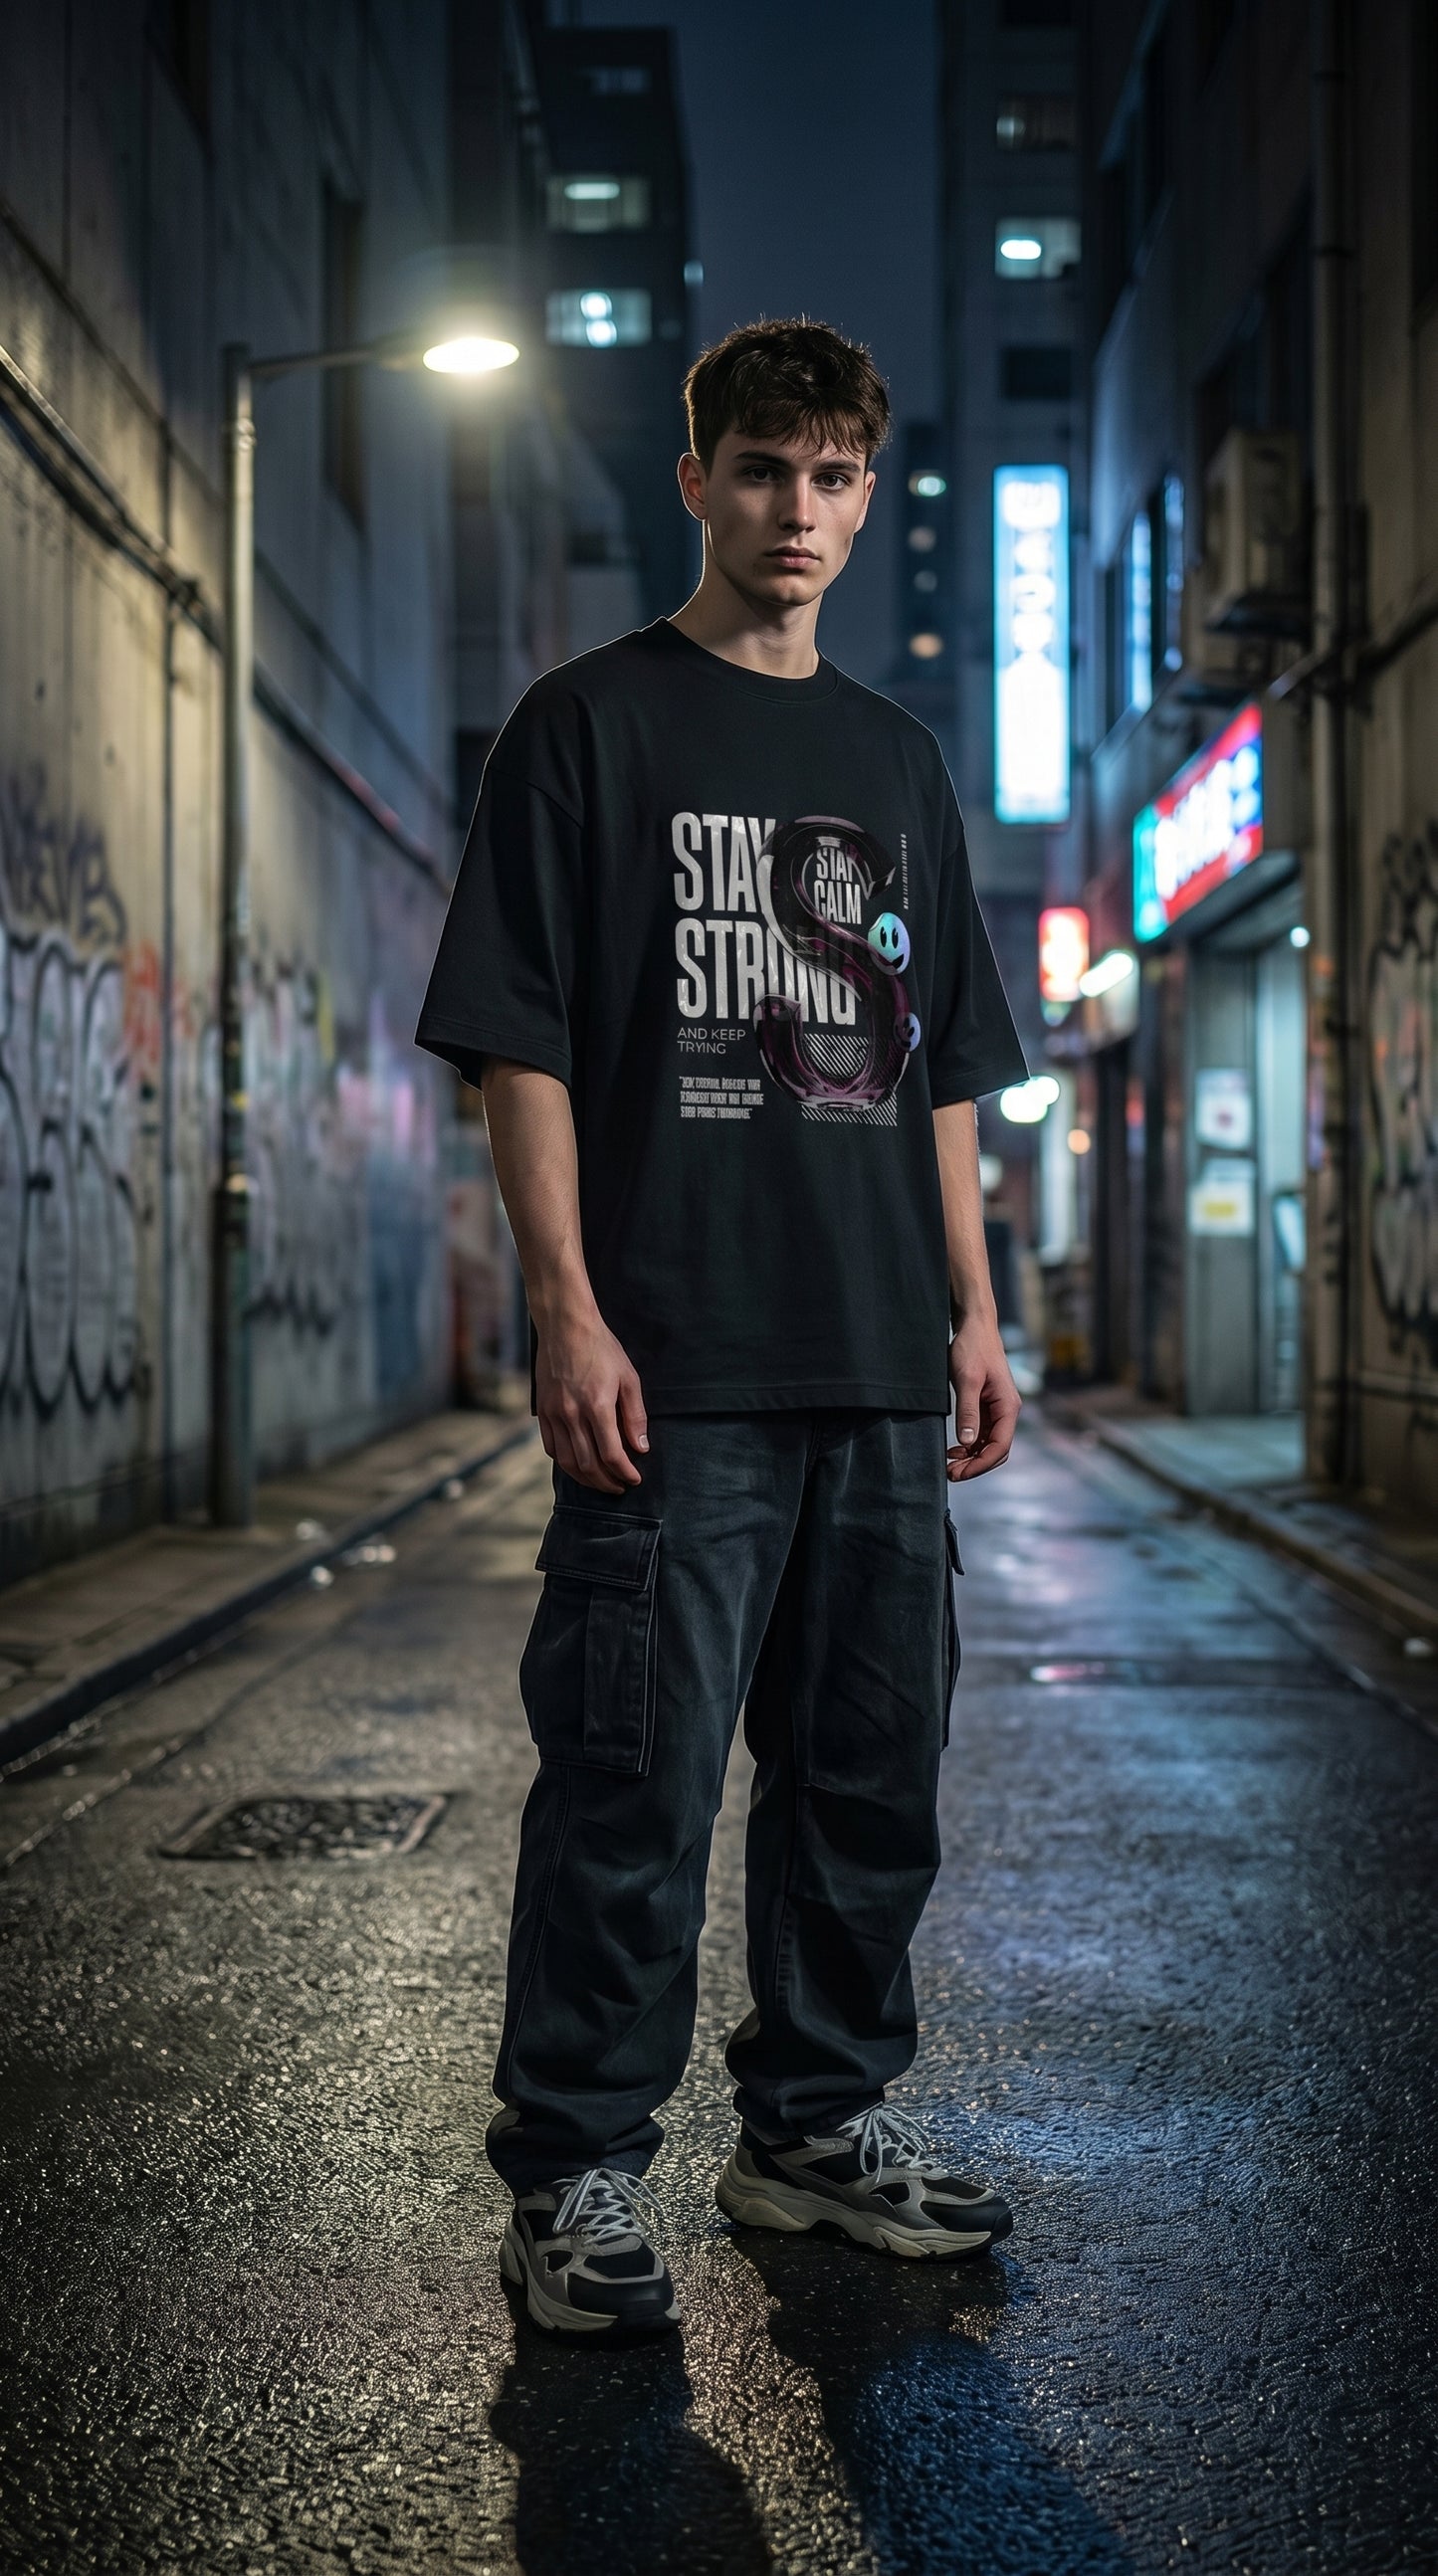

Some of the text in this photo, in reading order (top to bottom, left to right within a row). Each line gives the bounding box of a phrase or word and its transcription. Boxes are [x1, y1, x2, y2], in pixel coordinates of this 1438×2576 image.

[672, 811, 777, 912] STAY
[814, 880, 862, 924] CALM
[677, 1027, 746, 1041] AND KEEP
[677, 1041, 726, 1055] TRYING
